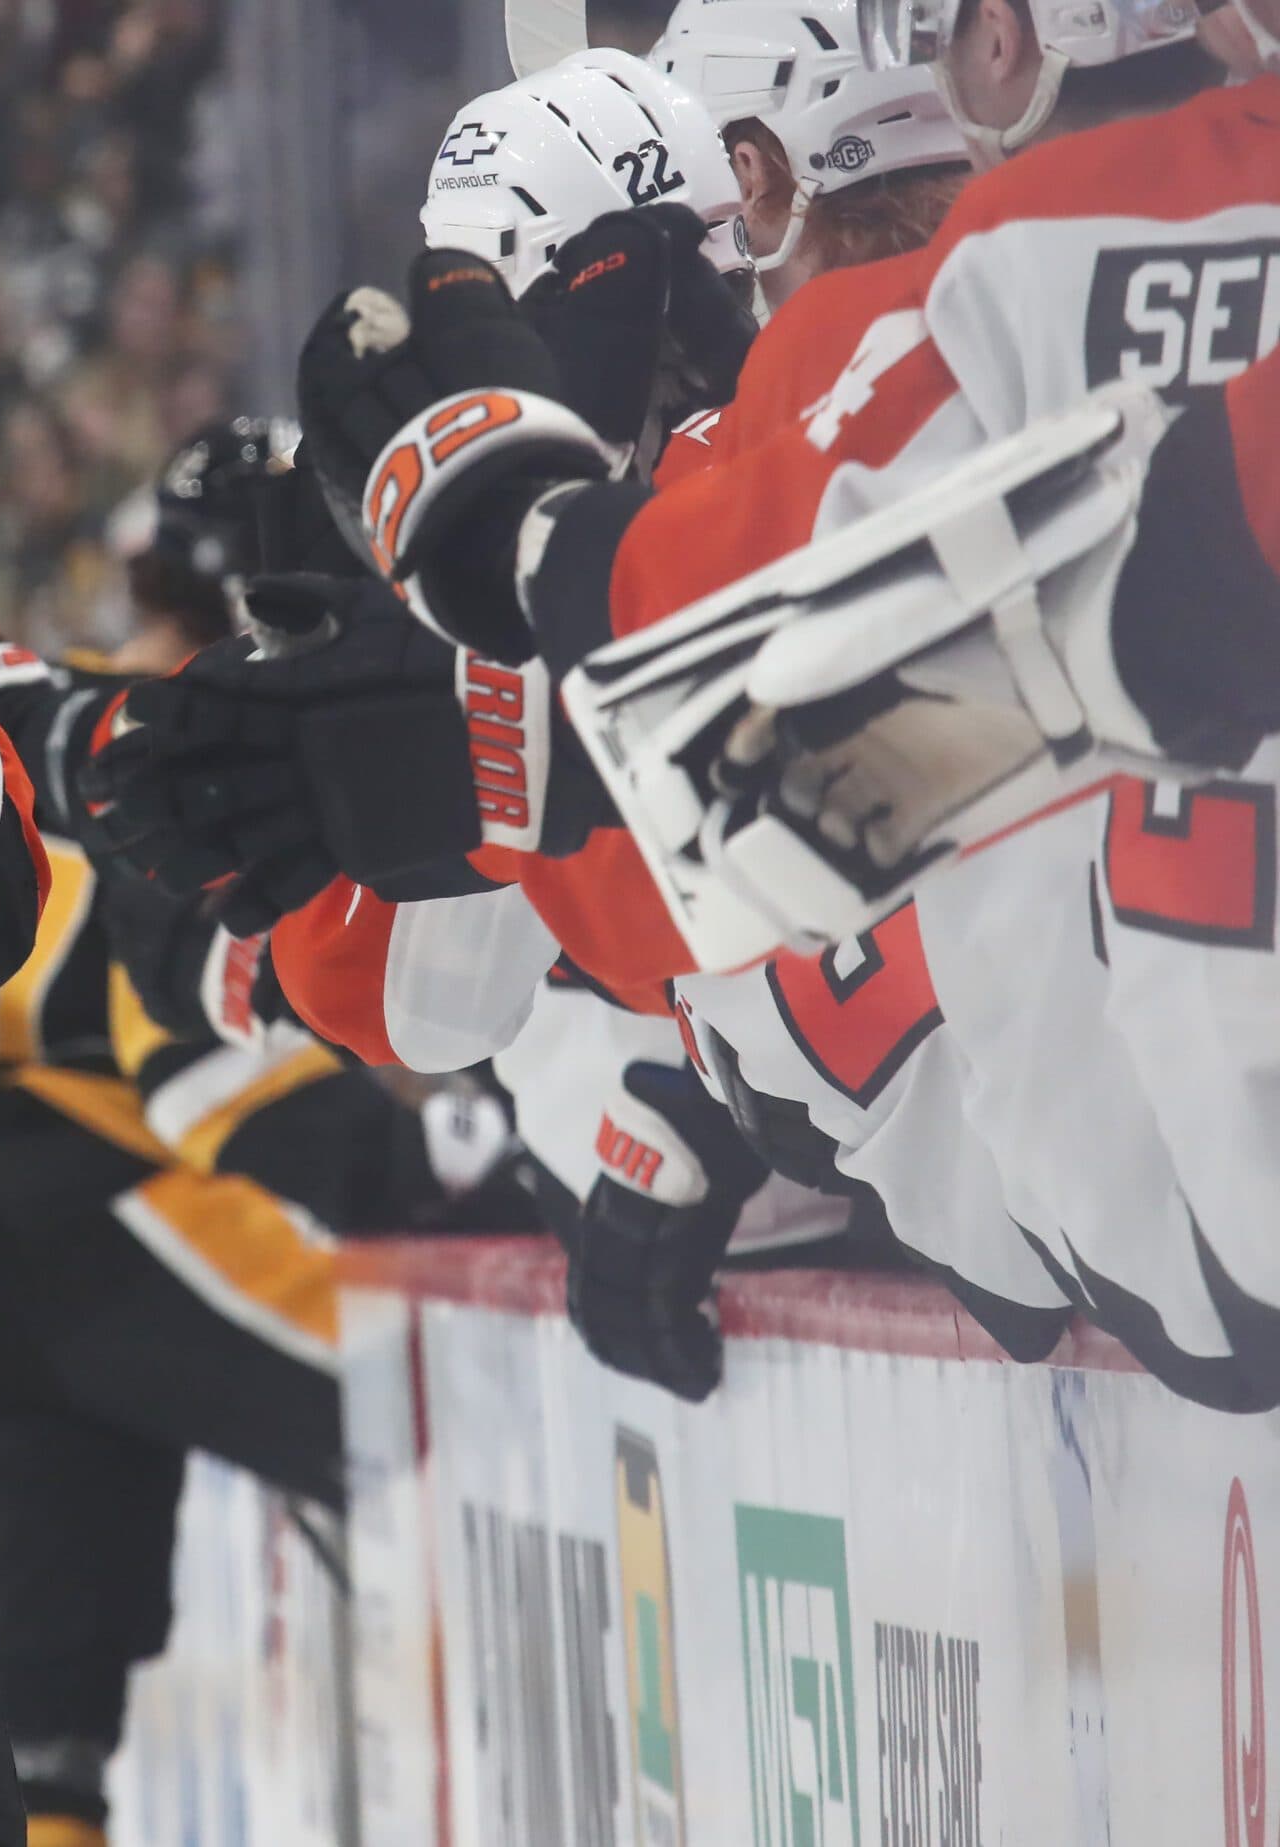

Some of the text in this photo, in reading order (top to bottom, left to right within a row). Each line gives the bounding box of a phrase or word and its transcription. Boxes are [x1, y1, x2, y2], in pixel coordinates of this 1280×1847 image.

[435, 173, 500, 191] CHEVROLET
[613, 138, 686, 206] 22
[466, 648, 530, 829] RIOR
[873, 1619, 931, 1847] EVERY
[933, 1628, 984, 1847] SAVE
